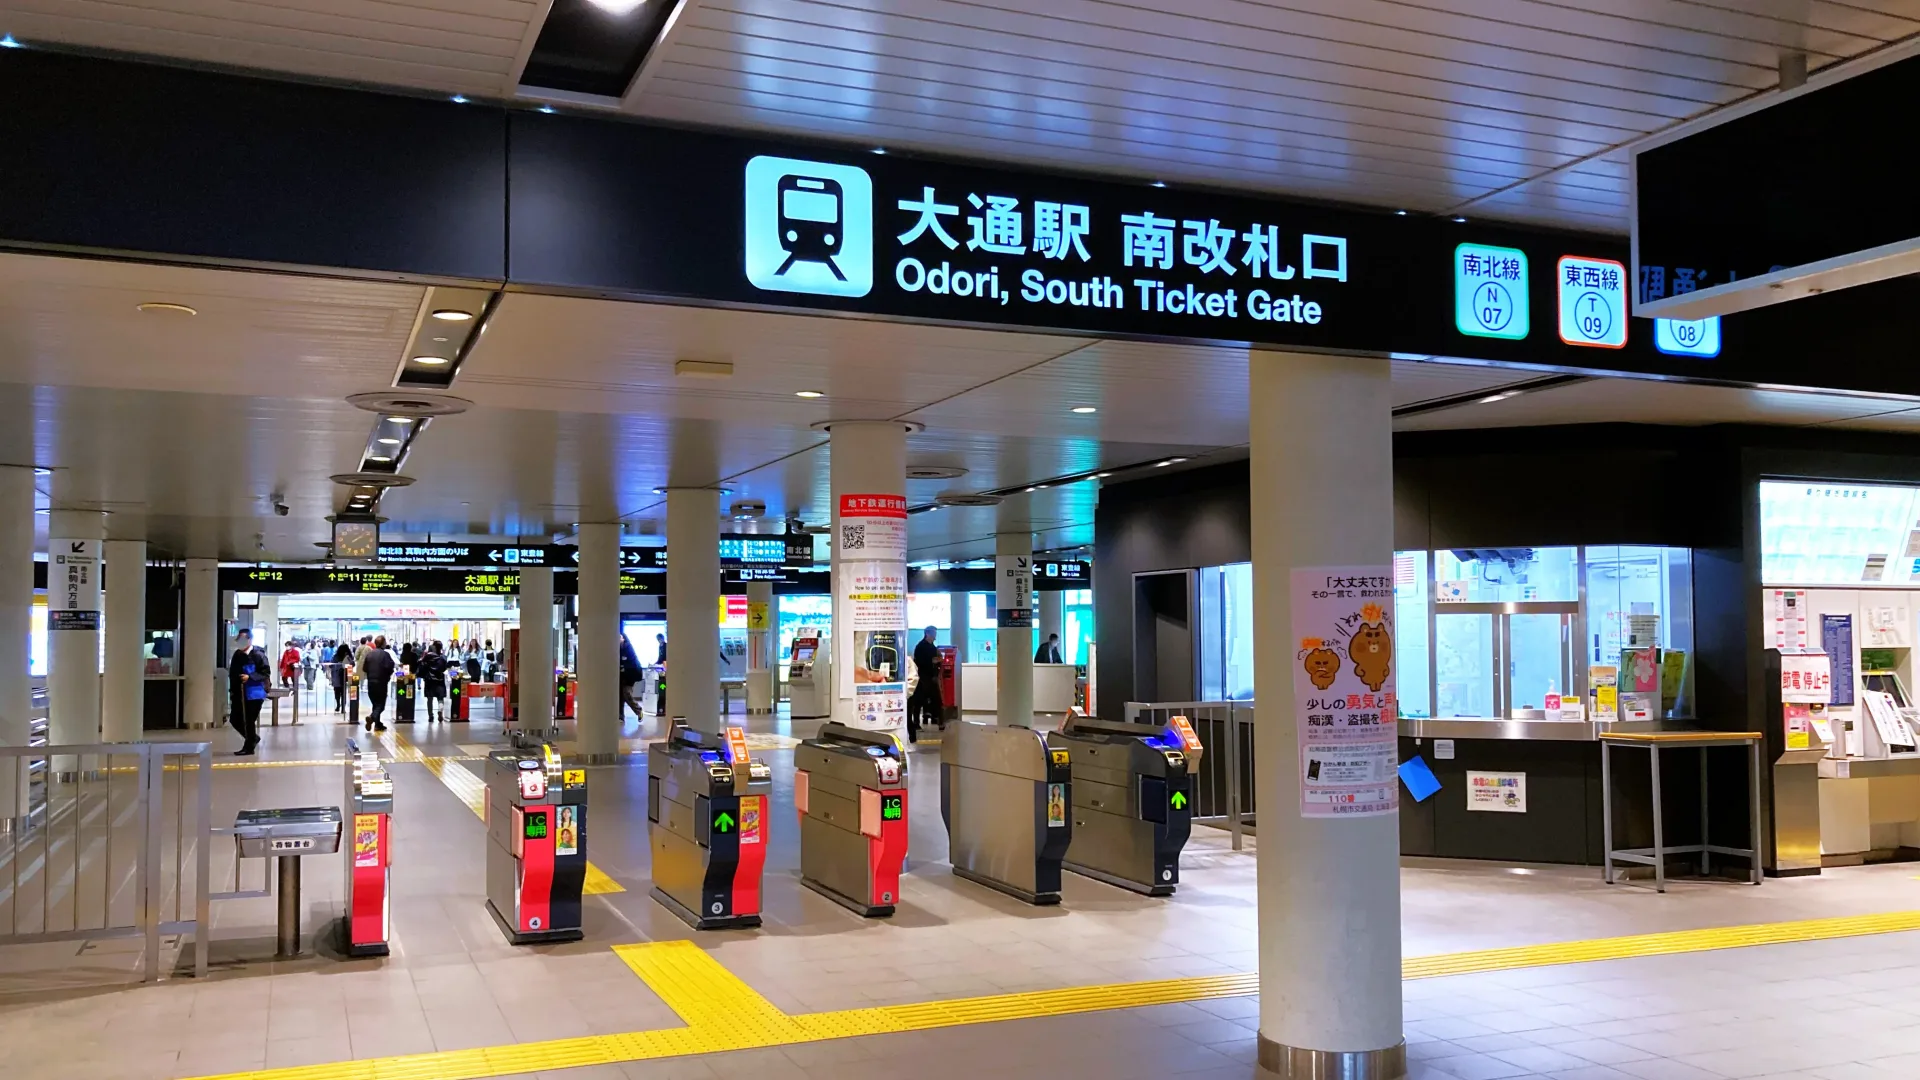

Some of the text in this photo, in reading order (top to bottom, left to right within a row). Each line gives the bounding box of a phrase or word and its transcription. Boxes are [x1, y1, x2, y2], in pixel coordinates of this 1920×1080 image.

[897, 187, 1347, 282] 大通駅 南改札口
[1463, 254, 1520, 280] 南北線
[1565, 265, 1619, 291] 東西線
[896, 258, 1321, 324] Odori, South Ticket Gate
[1487, 287, 1498, 303] N
[1588, 298, 1597, 312] T
[1483, 307, 1502, 324] 07
[1584, 317, 1602, 333] 09
[1678, 325, 1696, 341] 08
[271, 572, 283, 580] 12
[349, 573, 360, 582] 11
[464, 574, 499, 585] 大通駅
[531, 919, 539, 927] 4
